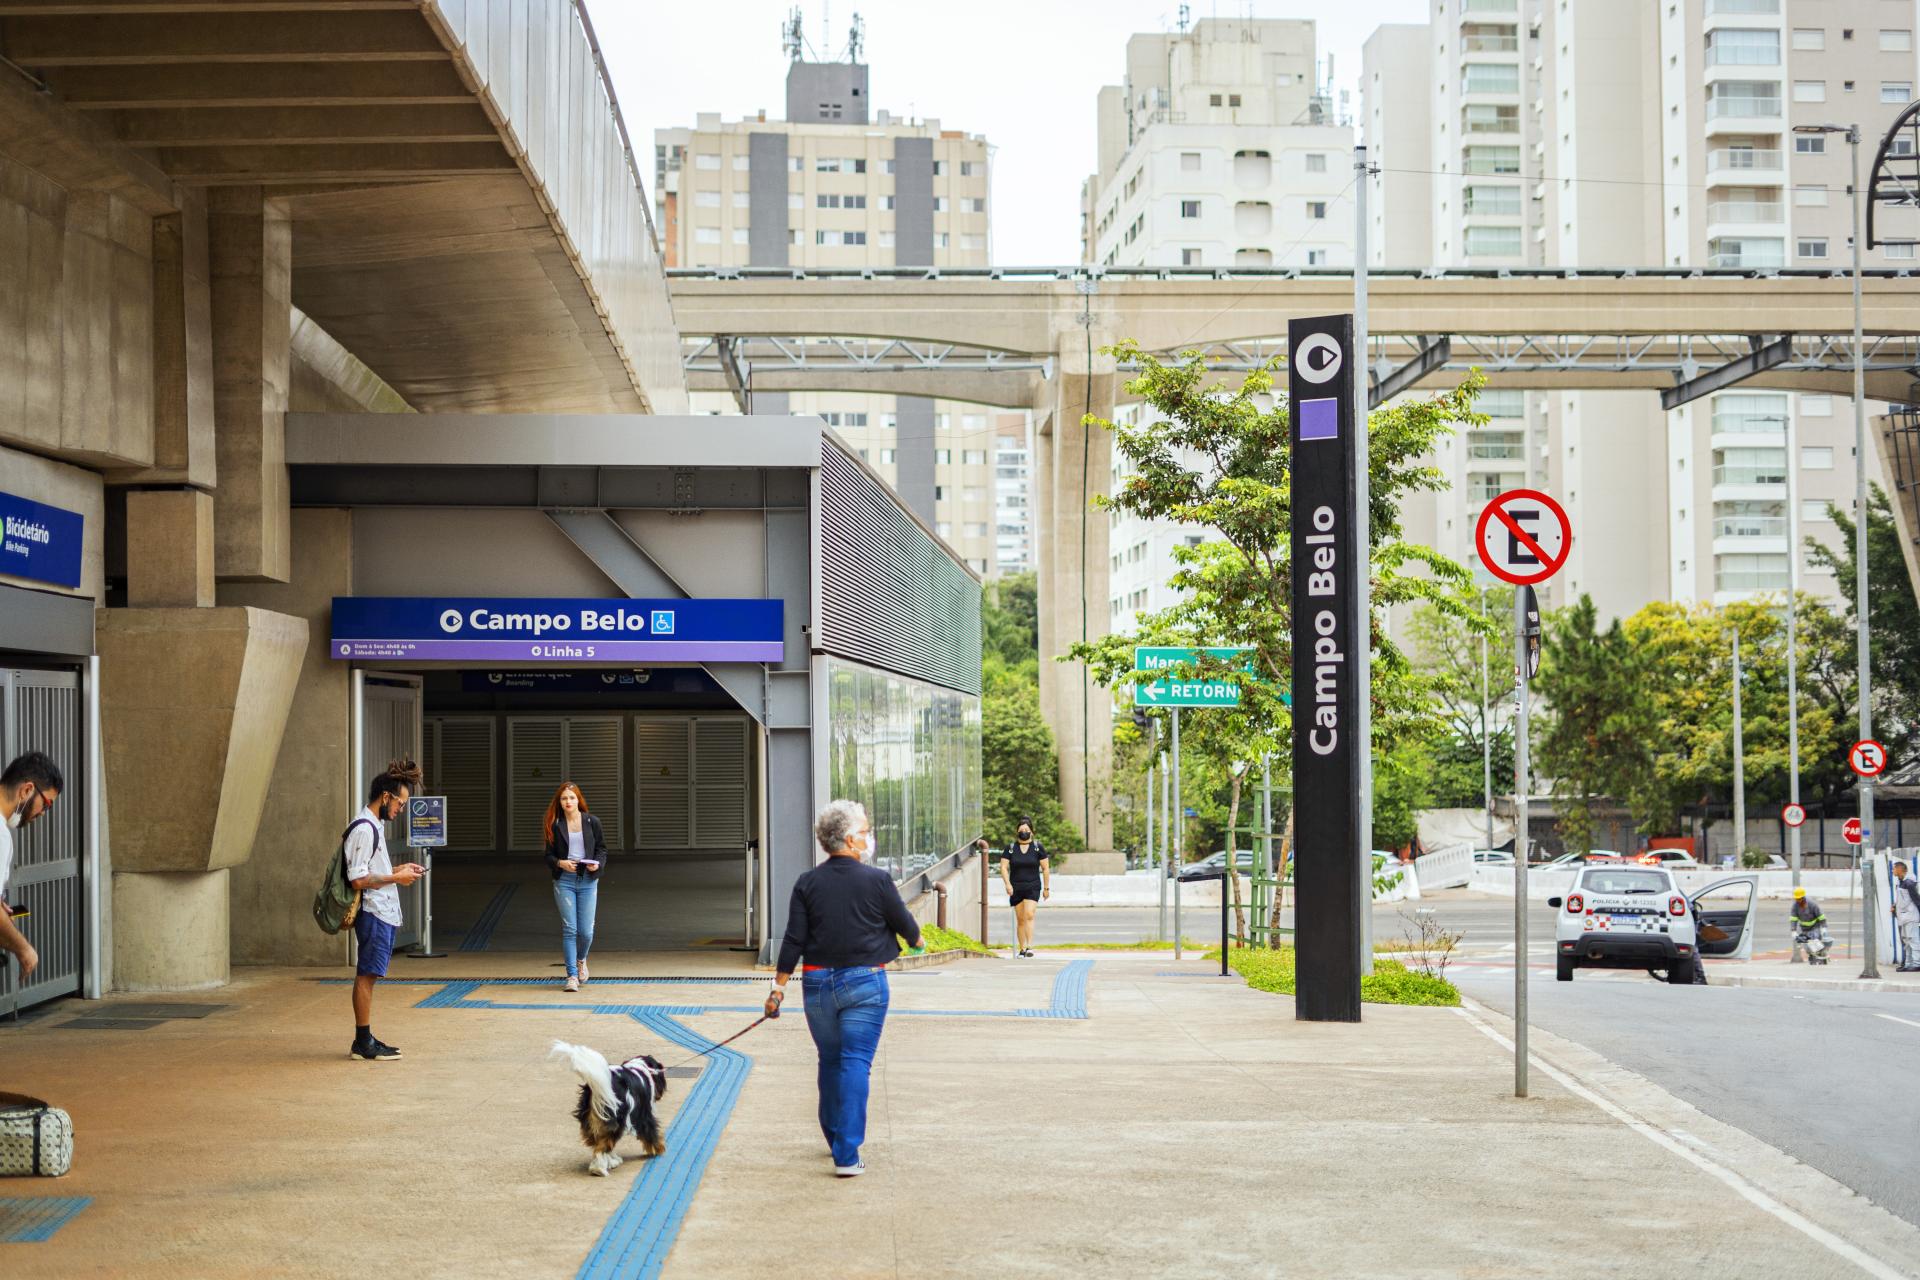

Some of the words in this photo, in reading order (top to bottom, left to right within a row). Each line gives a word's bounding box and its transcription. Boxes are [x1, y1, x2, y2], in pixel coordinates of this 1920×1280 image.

[6, 516, 49, 544] Bicicletário
[1508, 511, 1540, 564] E
[6, 541, 14, 552] Bike
[15, 542, 29, 557] Parking
[1305, 505, 1336, 597] Belo
[469, 608, 571, 635] Campo
[580, 608, 645, 631] Belo
[544, 646, 583, 657] Linha
[587, 646, 595, 657] 5
[505, 679, 534, 687] Boarding
[1171, 684, 1240, 698] RETORN
[1308, 609, 1344, 756] Campo
[1862, 749, 1873, 768] E
